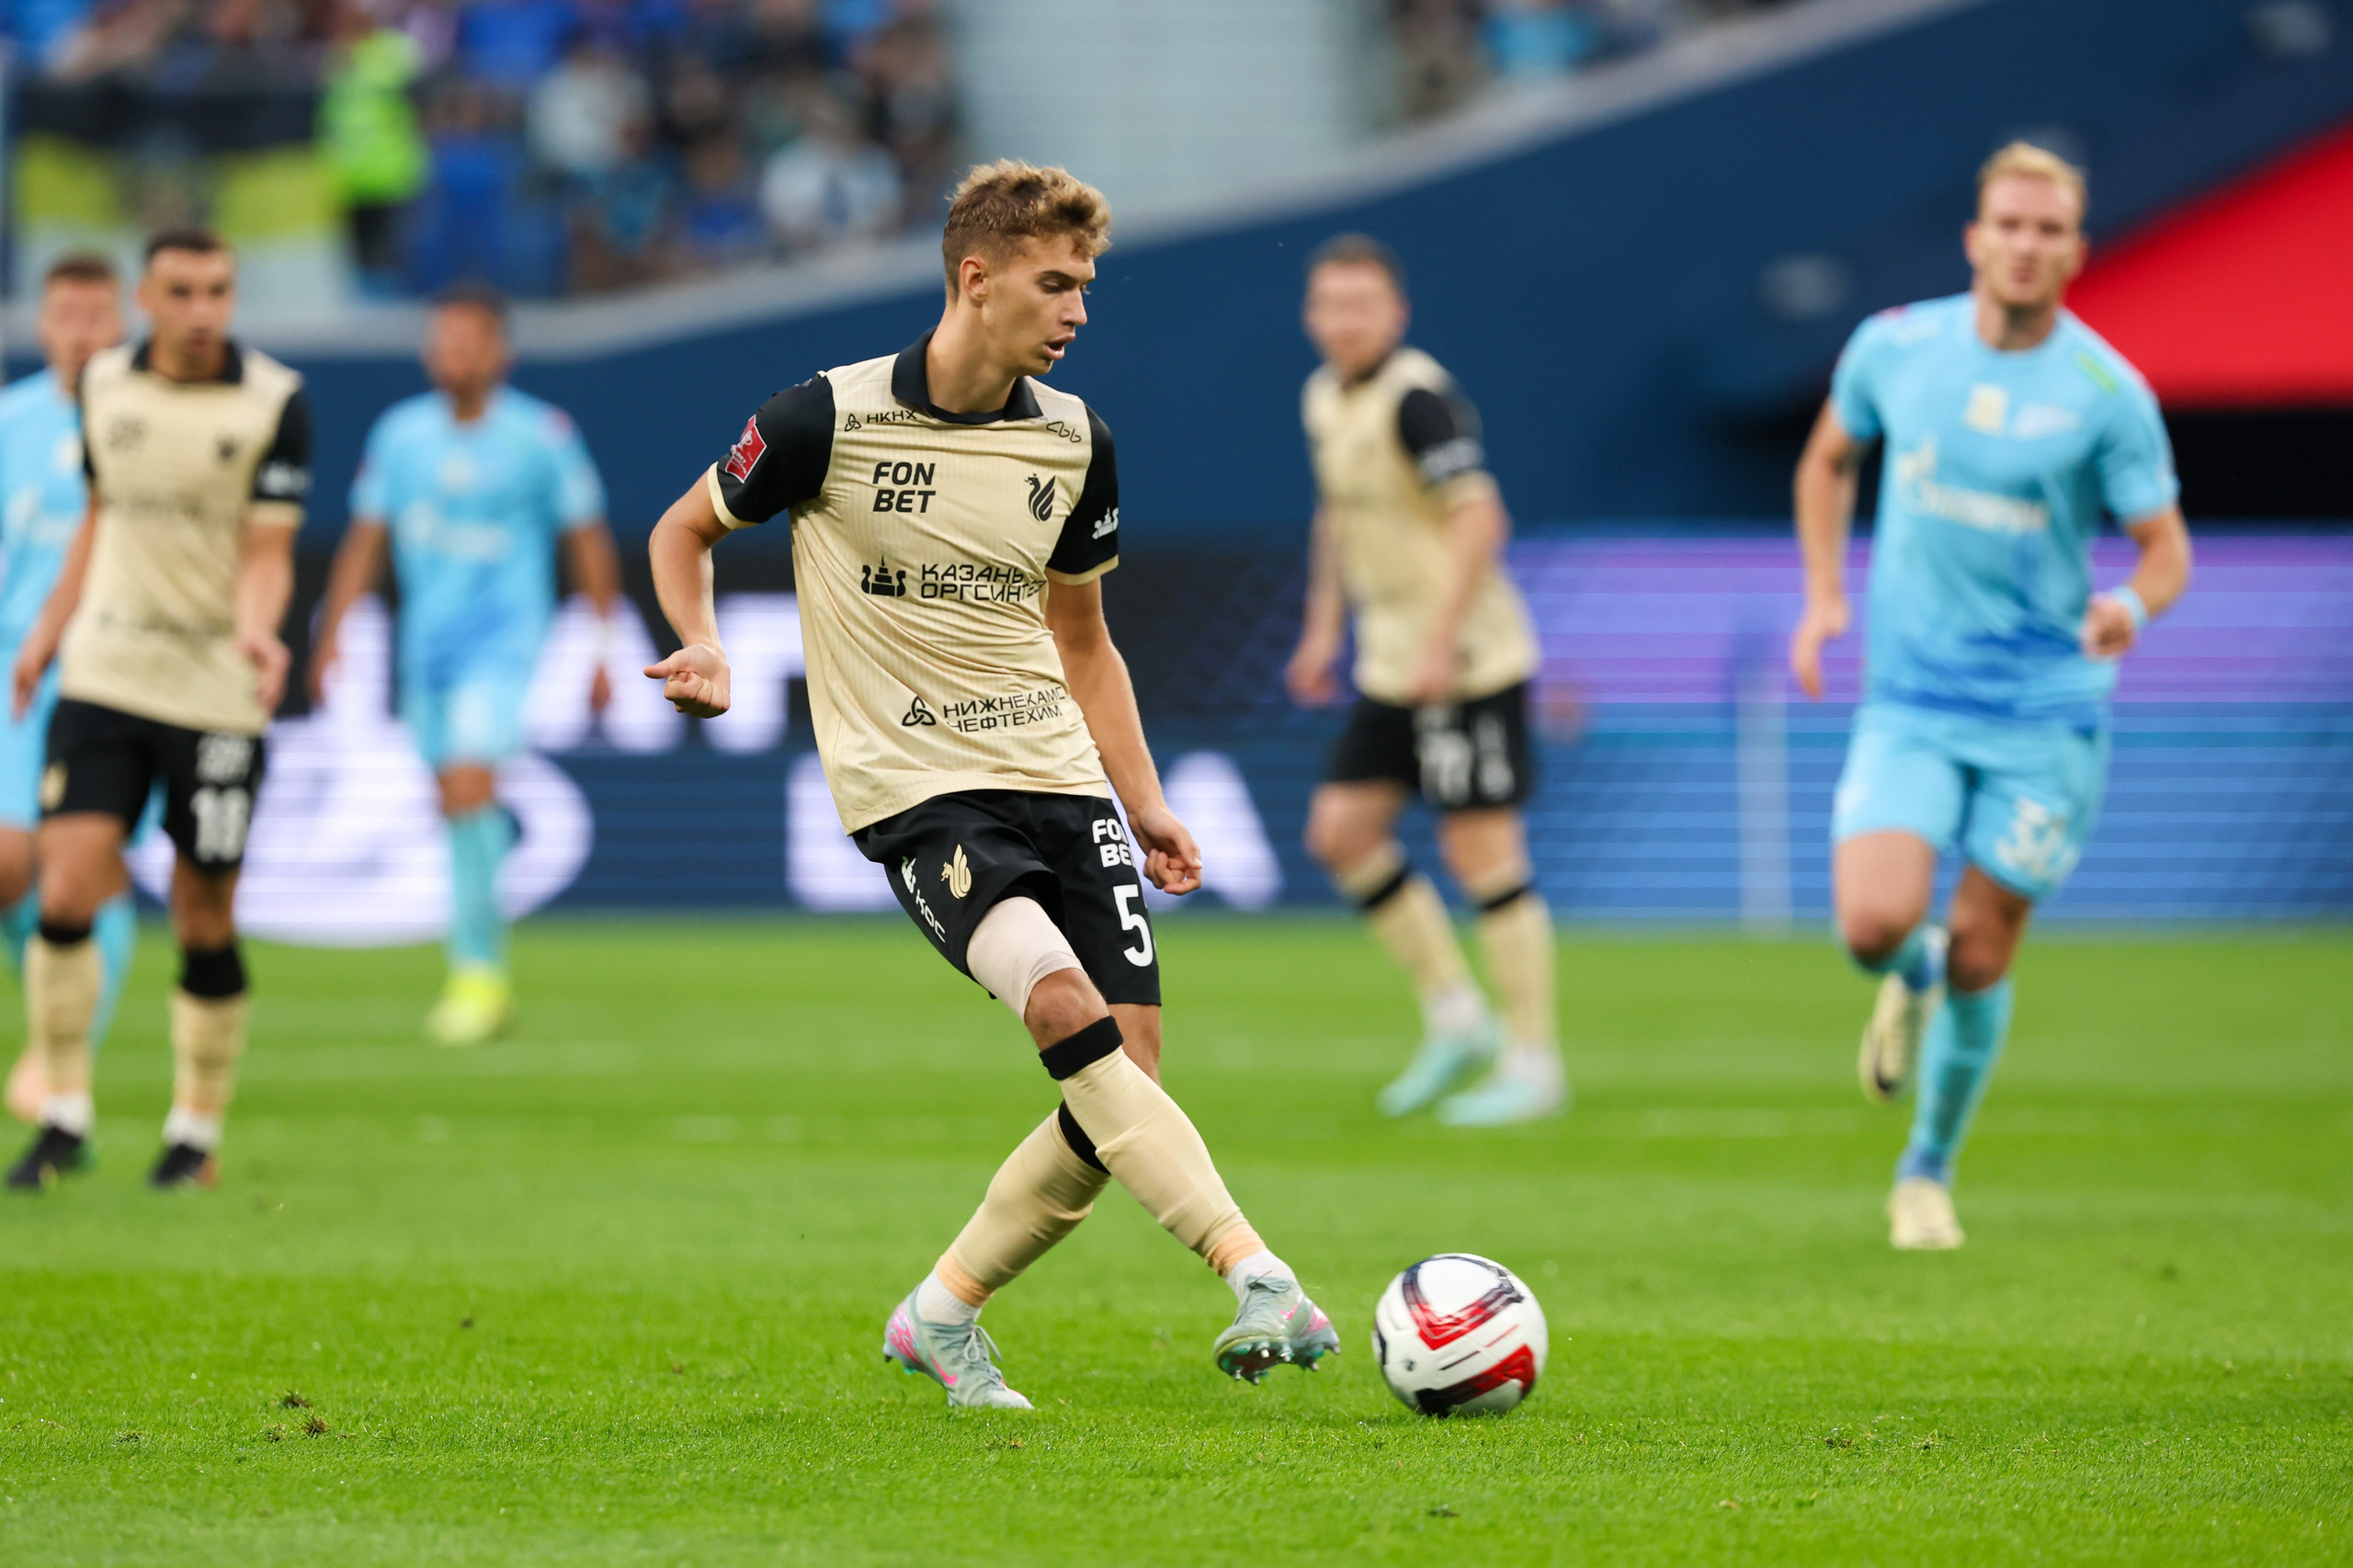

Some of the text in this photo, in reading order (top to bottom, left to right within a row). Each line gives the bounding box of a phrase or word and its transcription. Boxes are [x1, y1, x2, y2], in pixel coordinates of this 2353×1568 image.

[867, 410, 917, 424] НКНХ
[872, 461, 936, 485] FON
[872, 490, 937, 513] BET
[922, 563, 1024, 584] КАЗАНЬ
[1099, 844, 1136, 868] BE
[1112, 884, 1157, 967] 5
